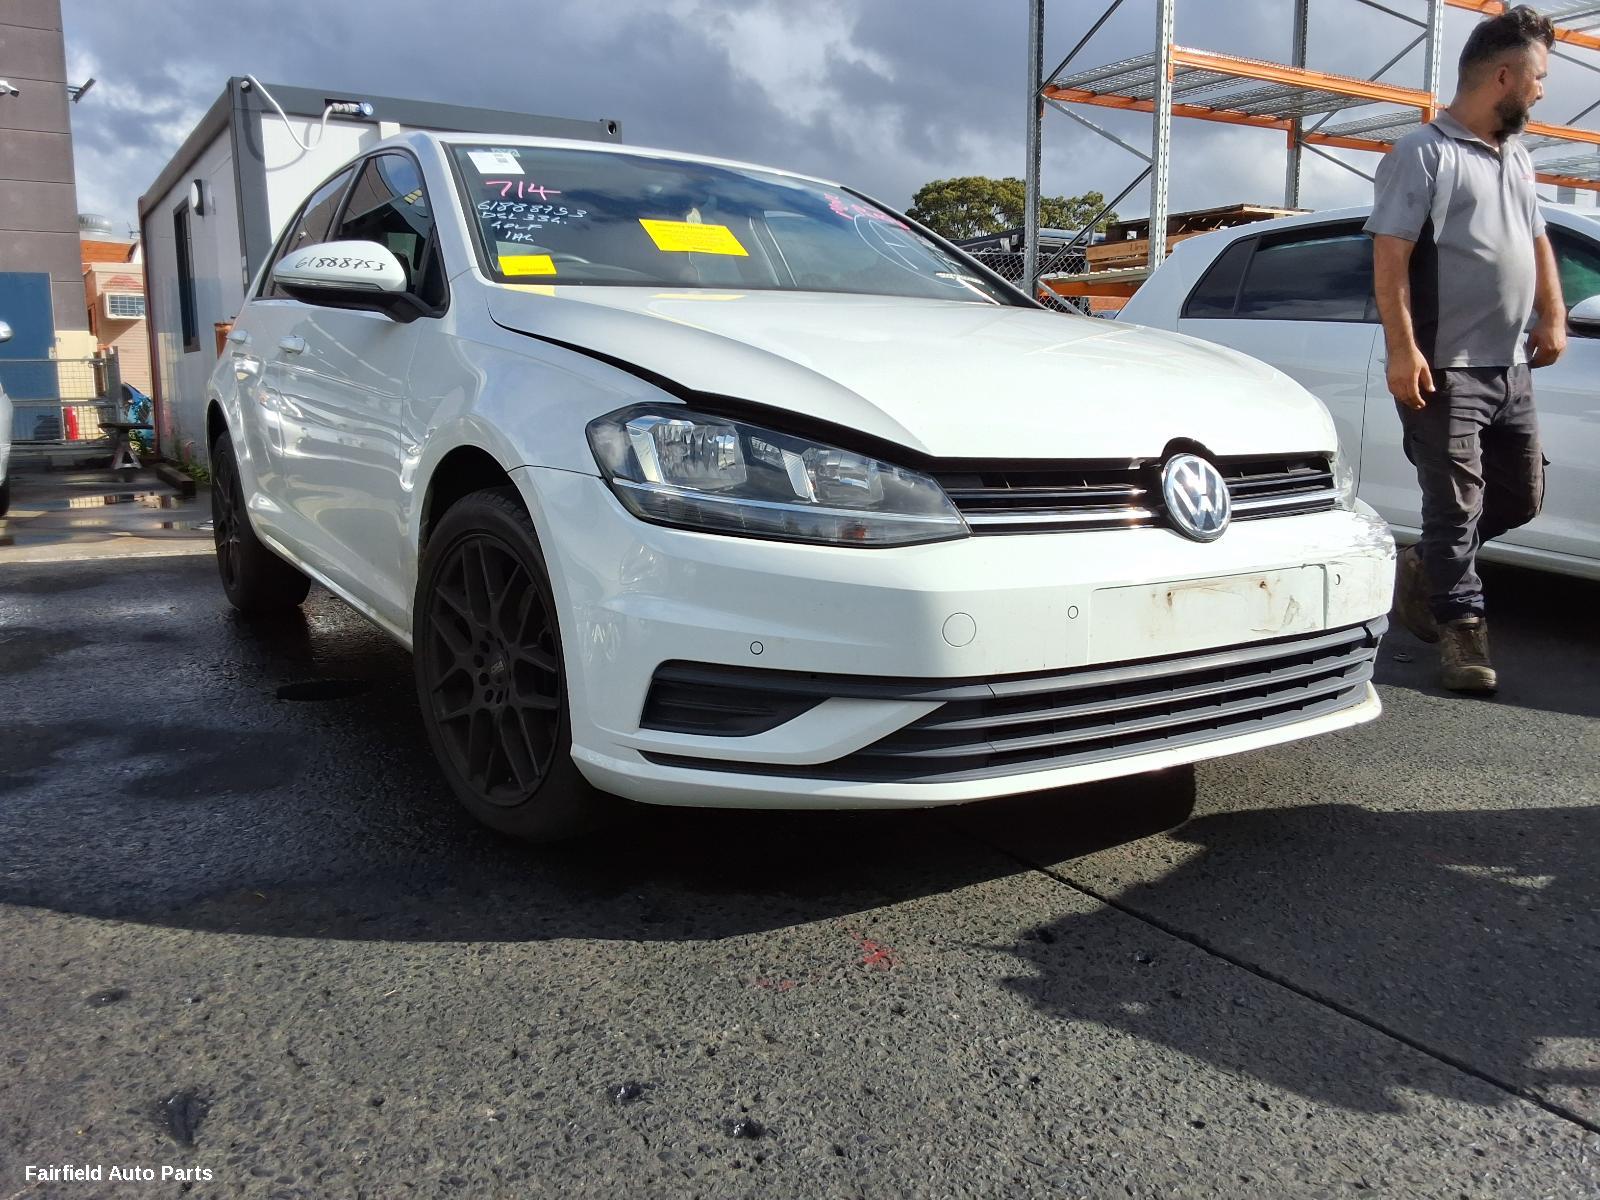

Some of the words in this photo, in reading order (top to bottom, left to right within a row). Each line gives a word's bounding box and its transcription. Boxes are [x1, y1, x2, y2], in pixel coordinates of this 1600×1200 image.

[485, 180, 561, 201] 714
[478, 201, 588, 218] 61888753
[295, 256, 386, 272] 61888753
[1164, 455, 1229, 537] VW
